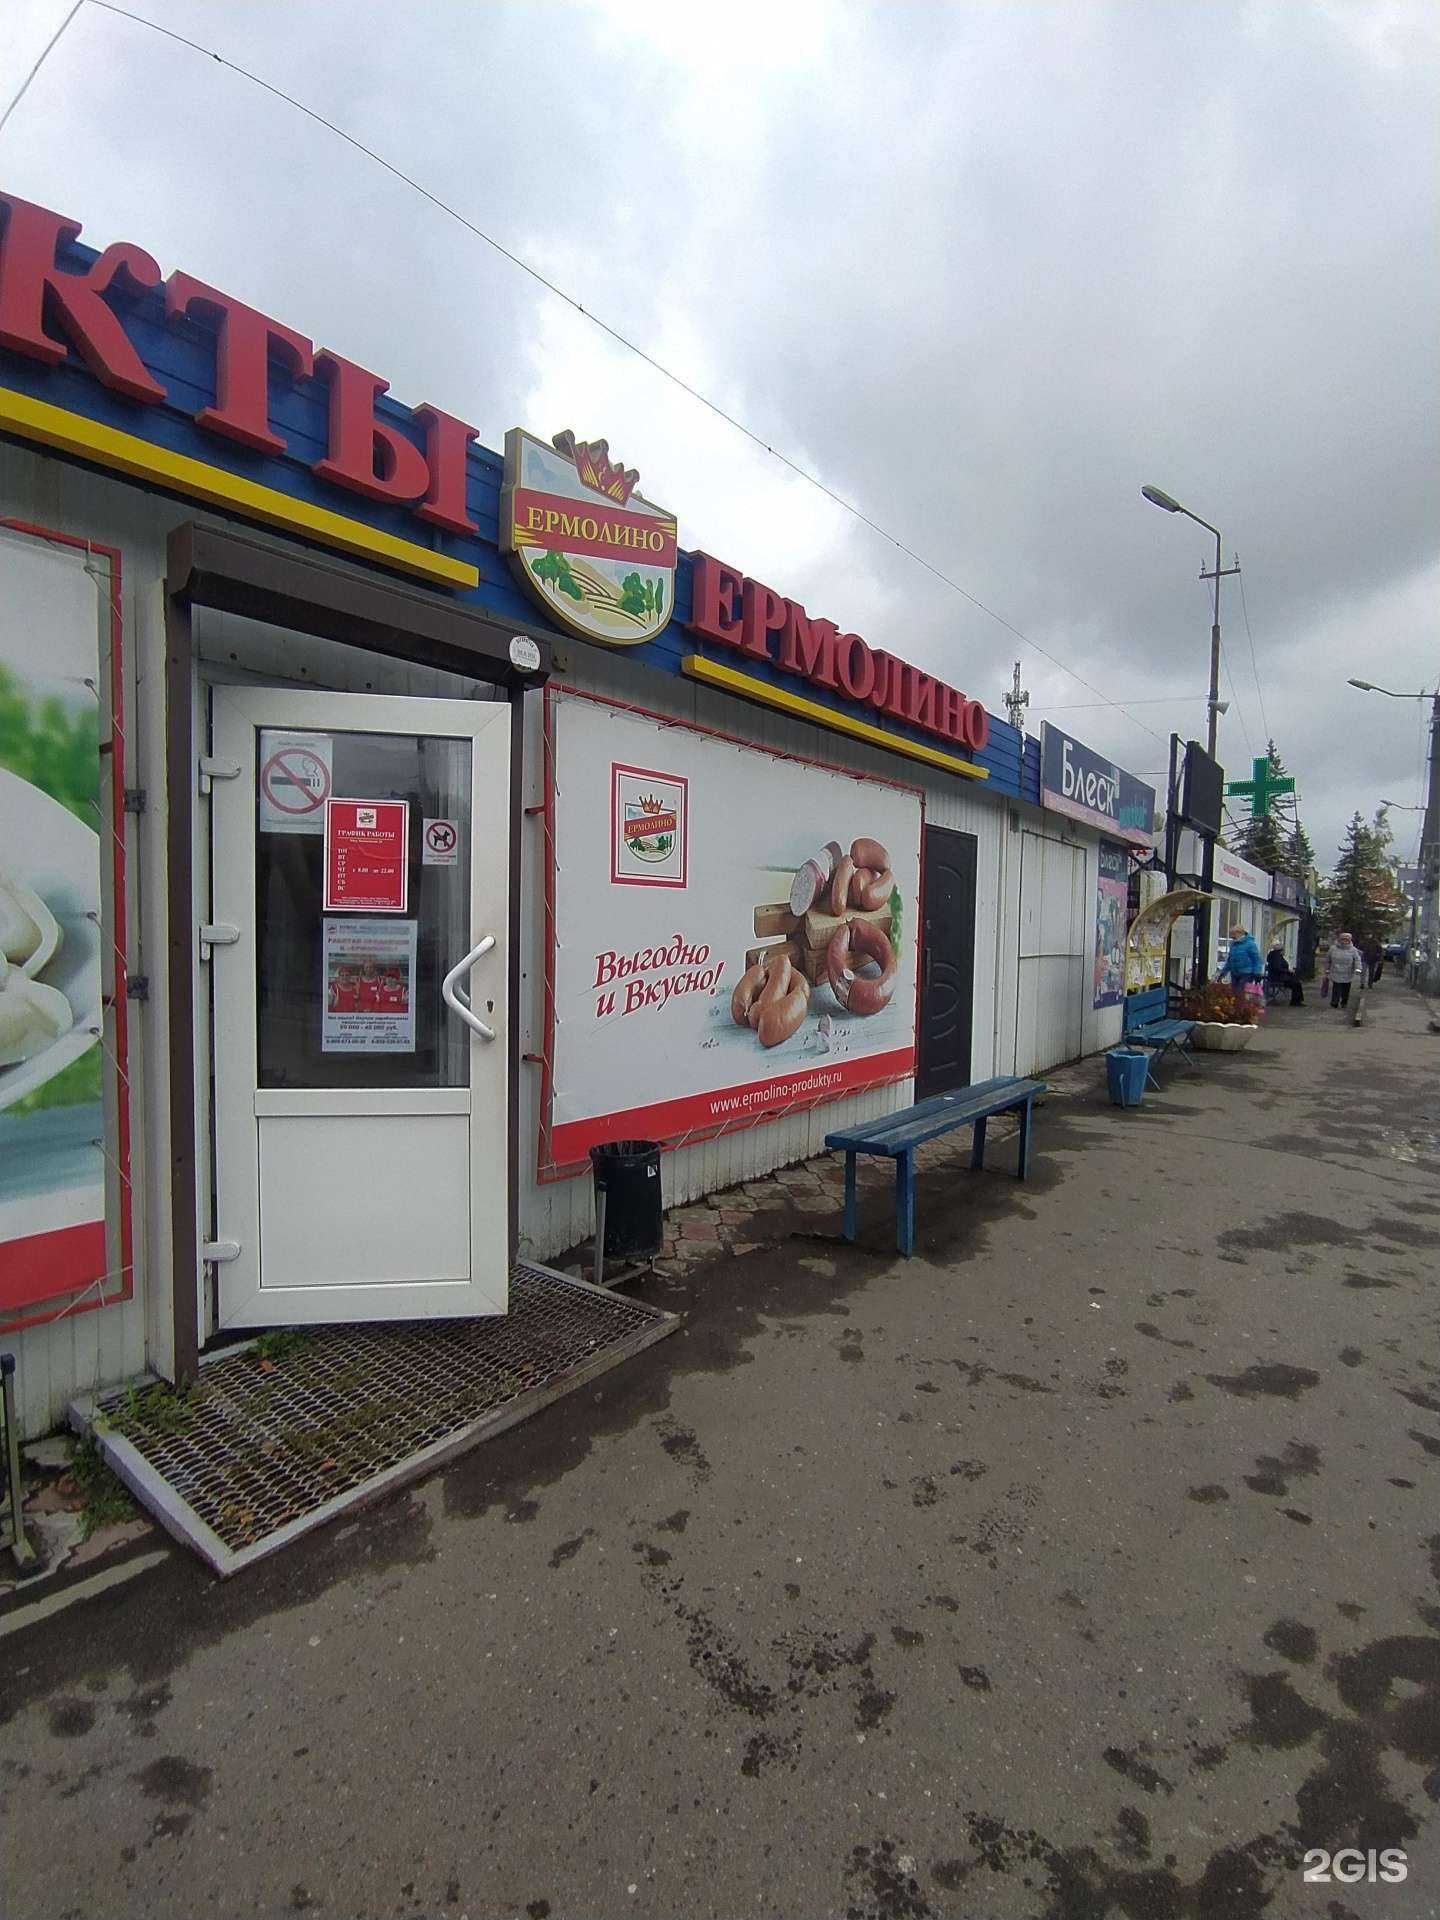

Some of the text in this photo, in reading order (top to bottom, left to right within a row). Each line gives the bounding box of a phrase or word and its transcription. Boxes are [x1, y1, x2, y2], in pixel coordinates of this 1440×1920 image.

[0, 190, 989, 750] КТЫ ЕРМОЛИНО
[527, 506, 665, 552] ЕРМОЛИНО
[337, 829, 395, 838] ГРАФИК РАБОТЫ
[627, 816, 674, 834] ЕРМОЛИНО
[592, 934, 710, 989] Выгодно
[596, 961, 725, 1018] и Вкусно!
[710, 1070, 842, 1114] www.ermolino-produkty.ru
